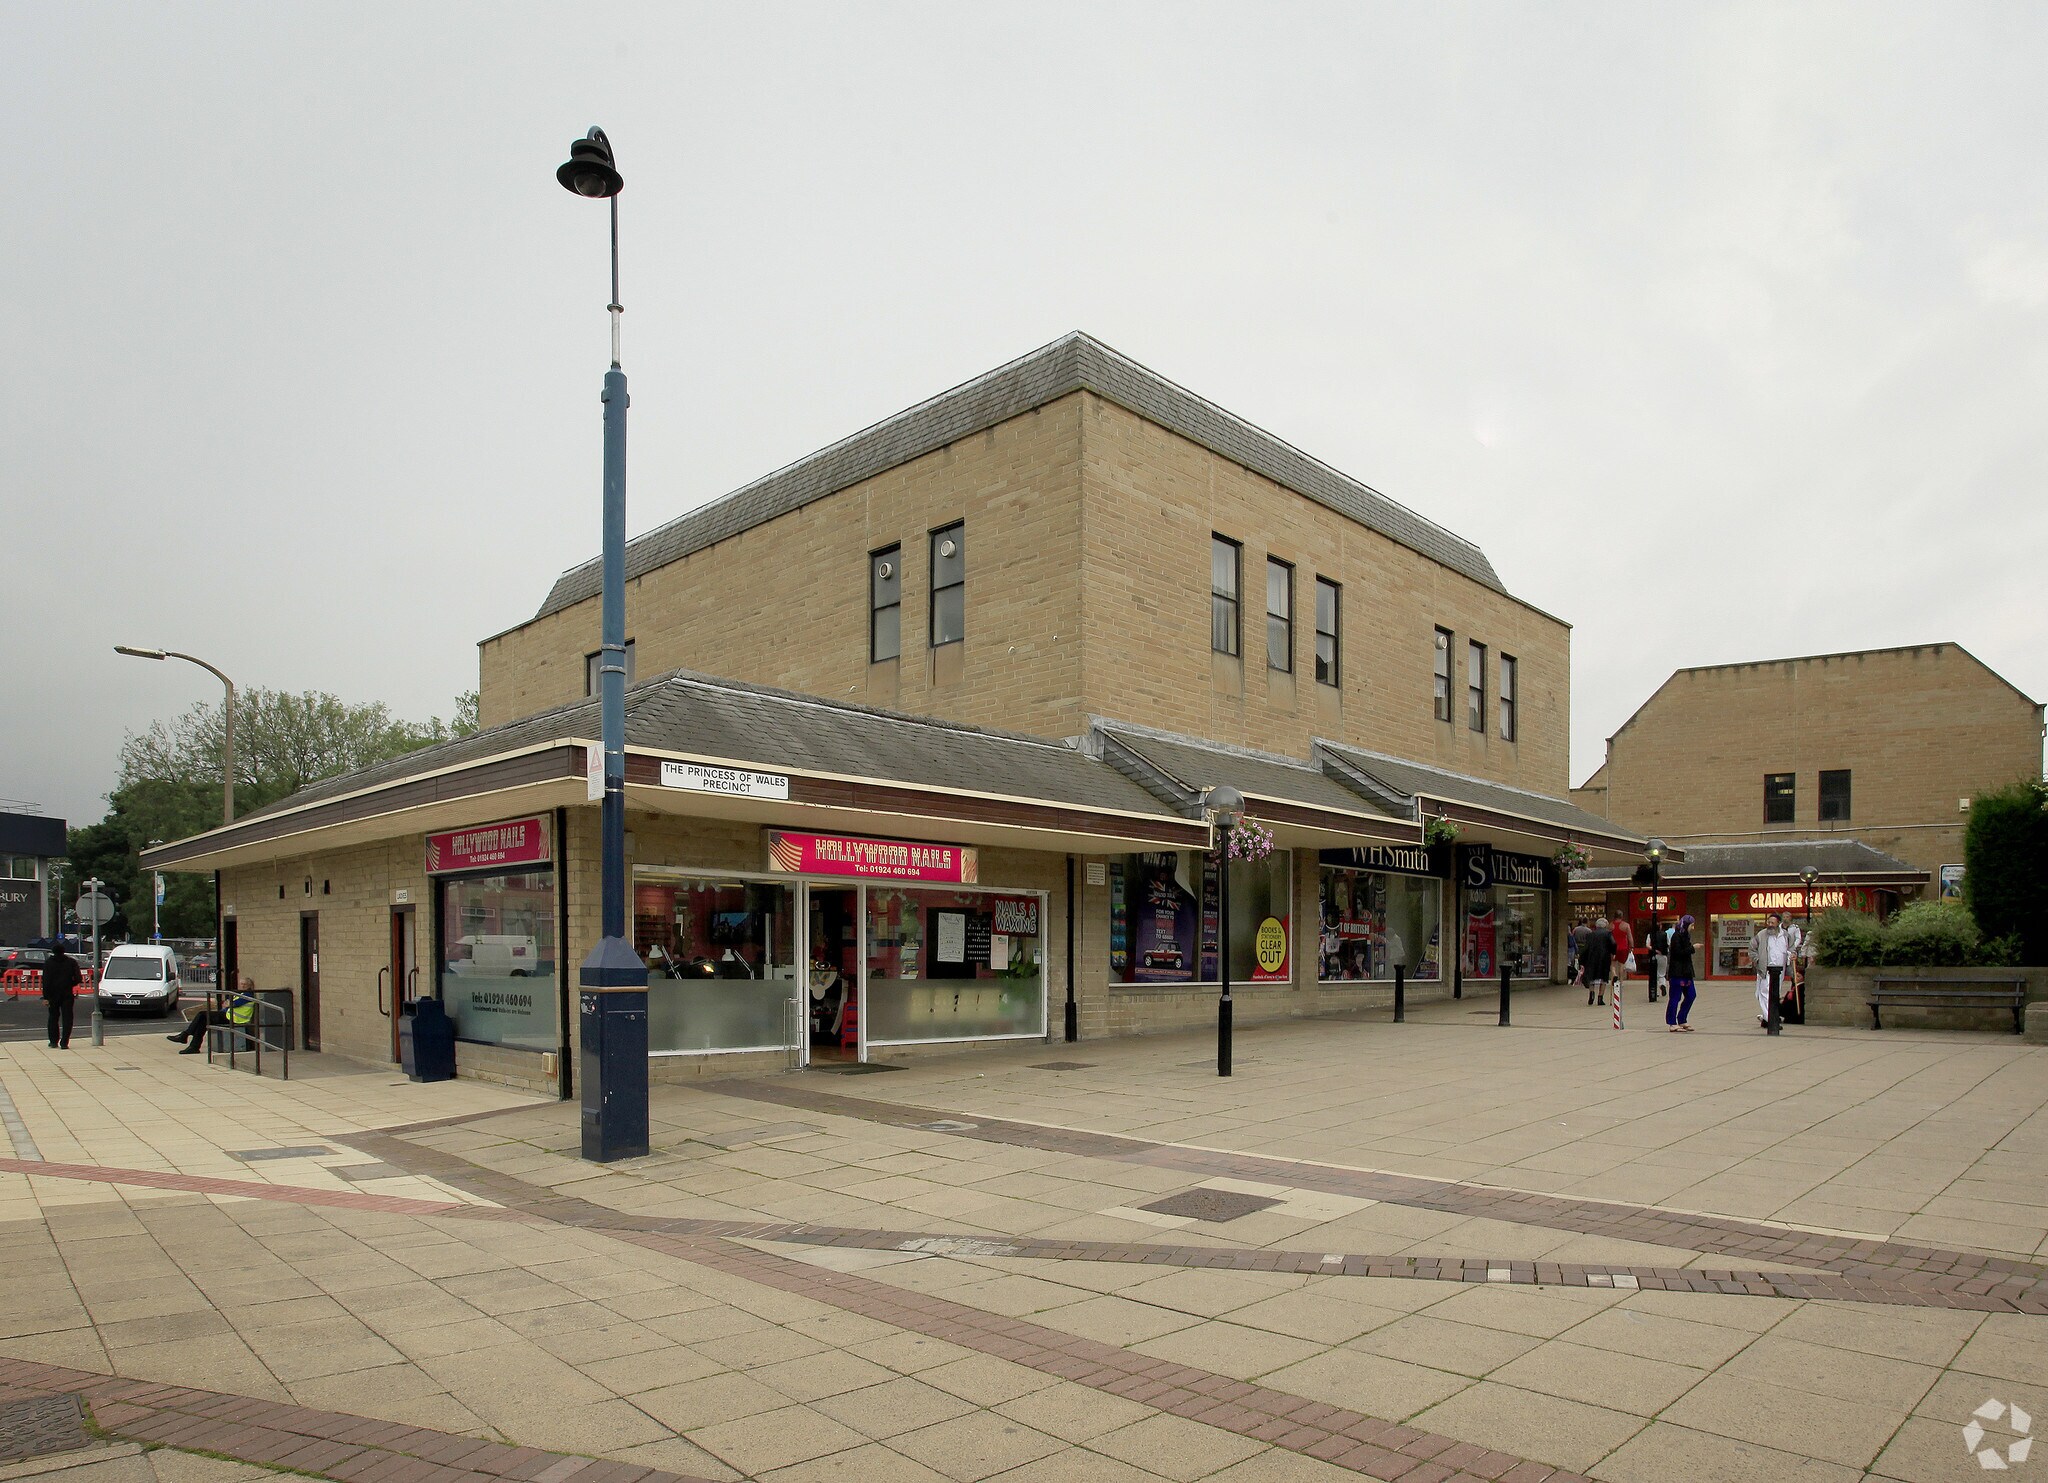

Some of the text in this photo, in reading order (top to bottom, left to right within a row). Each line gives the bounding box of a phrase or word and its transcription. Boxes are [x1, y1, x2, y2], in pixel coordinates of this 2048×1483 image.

[665, 764, 785, 787] THE PRINCESS OF WALES
[703, 779, 751, 792] PRECINCT
[452, 825, 525, 856] HOLLYWOOD NAILS
[816, 839, 951, 869] HOLLYWOOD NAILS
[870, 866, 891, 874] 01924
[893, 867, 905, 875] 460
[908, 868, 920, 876] 694
[1750, 892, 1802, 908] GRAINGER
[995, 900, 1036, 918] NAILS &
[995, 915, 1036, 933] WAXING
[1261, 940, 1281, 949] CLEAR
[1261, 951, 1281, 963] OUT
[472, 992, 532, 1007] Tel: 01924 460 694
